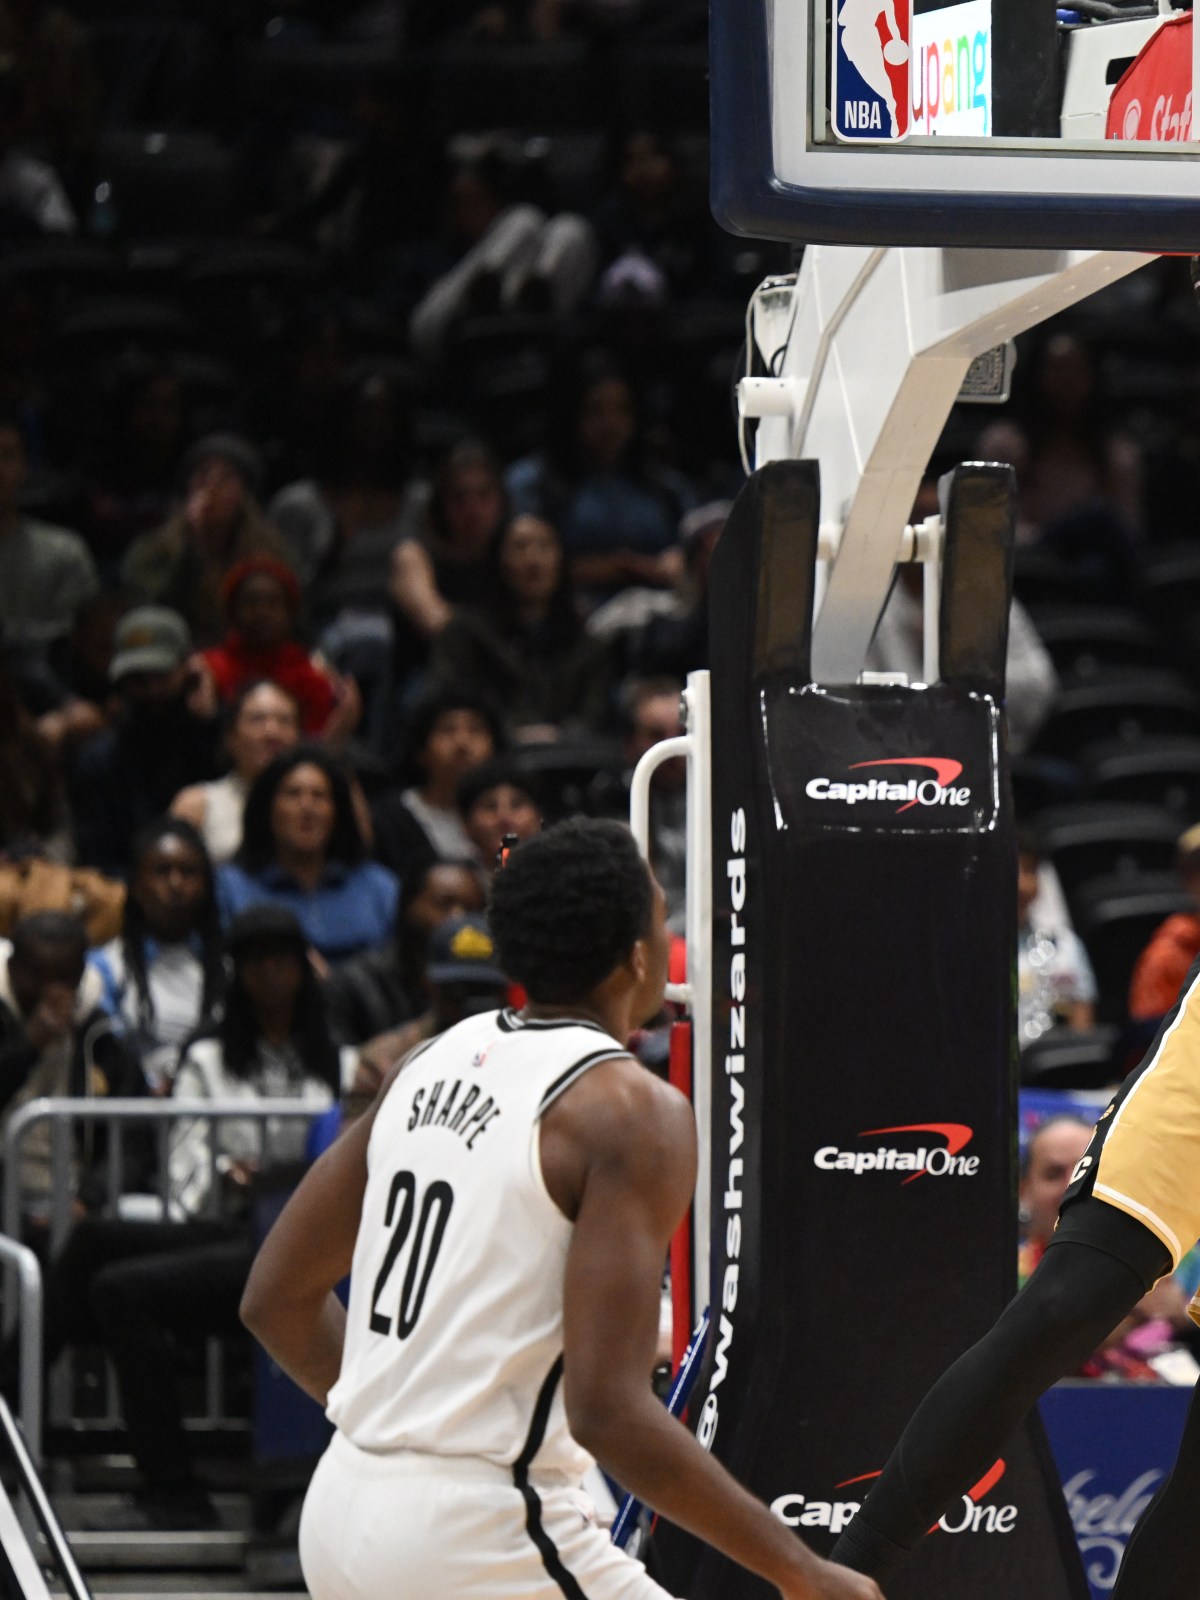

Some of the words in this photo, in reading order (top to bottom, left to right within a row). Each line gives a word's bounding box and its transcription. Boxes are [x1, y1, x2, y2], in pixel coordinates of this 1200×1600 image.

[845, 101, 881, 129] NBA
[408, 1080, 501, 1151] SHARPE
[696, 807, 746, 1451] @washwizards
[369, 1170, 454, 1341] 20
